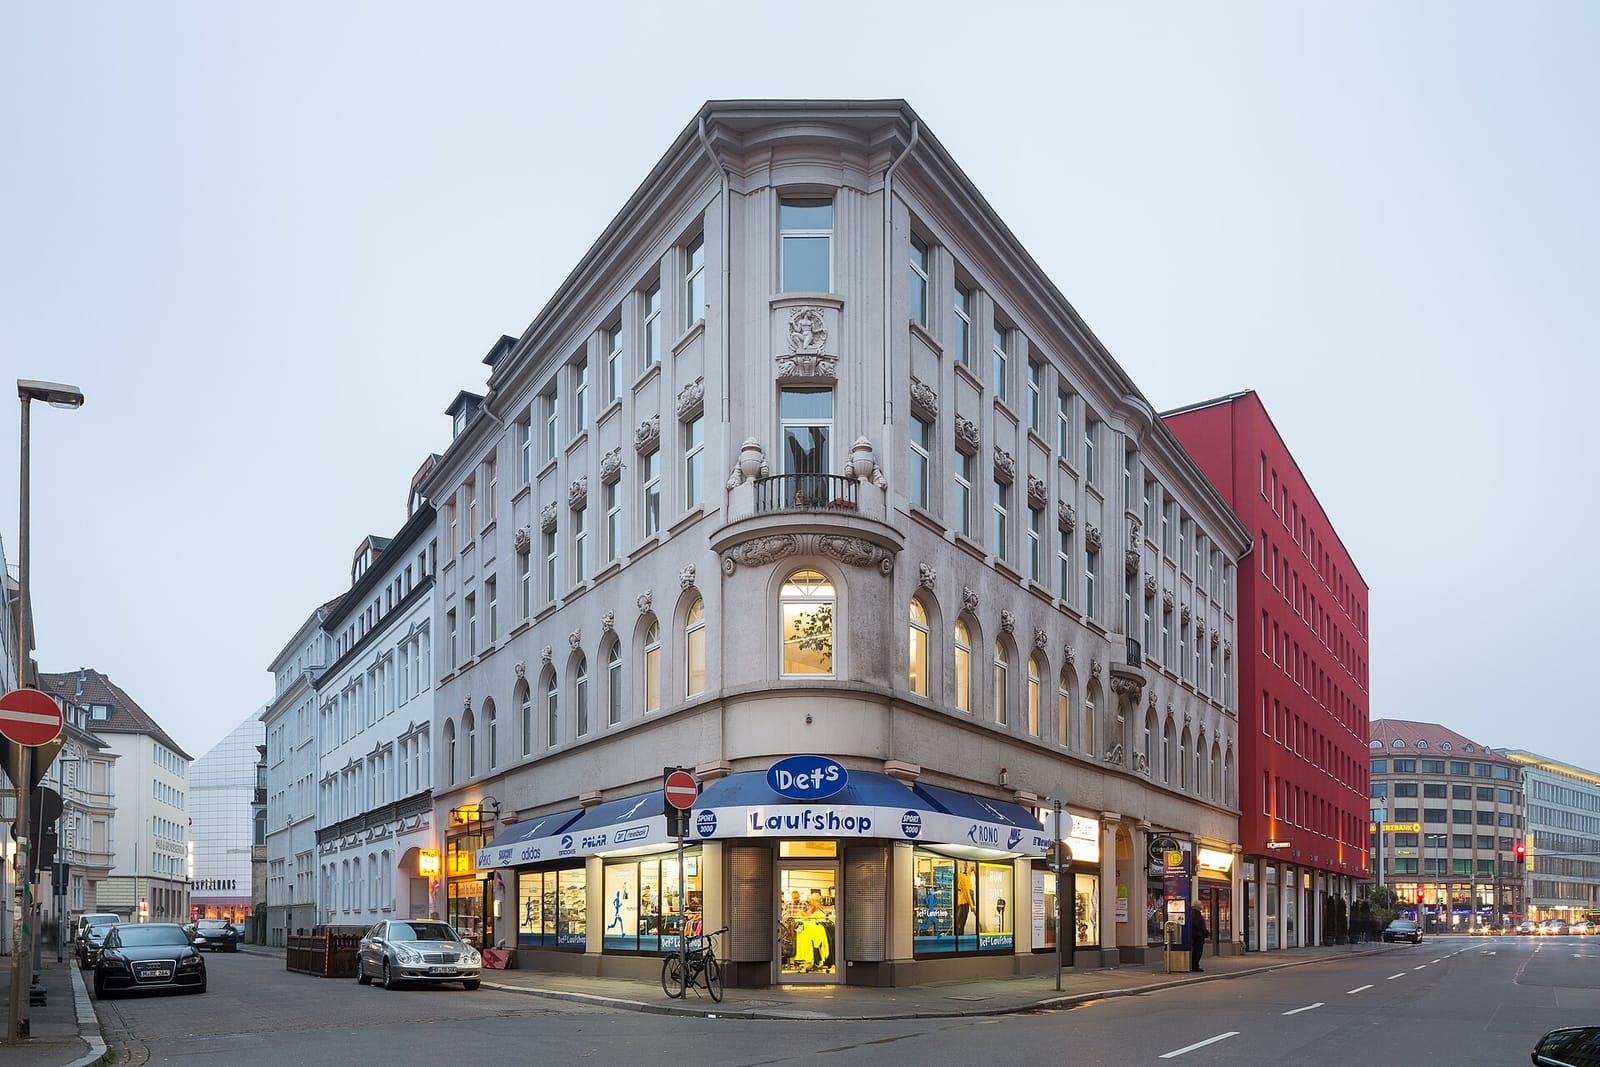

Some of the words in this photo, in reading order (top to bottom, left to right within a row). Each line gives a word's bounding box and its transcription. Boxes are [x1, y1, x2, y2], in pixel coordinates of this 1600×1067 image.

[775, 765, 840, 791] Dets
[697, 814, 714, 823] SPORT
[750, 809, 872, 834] Laufshop
[902, 814, 920, 824] SPORT
[699, 825, 714, 833] 2000
[904, 826, 919, 834] 2000
[979, 825, 998, 843] RONO
[581, 834, 607, 848] POLAR
[521, 847, 541, 861] adidas
[991, 935, 1013, 946] Laufshop
